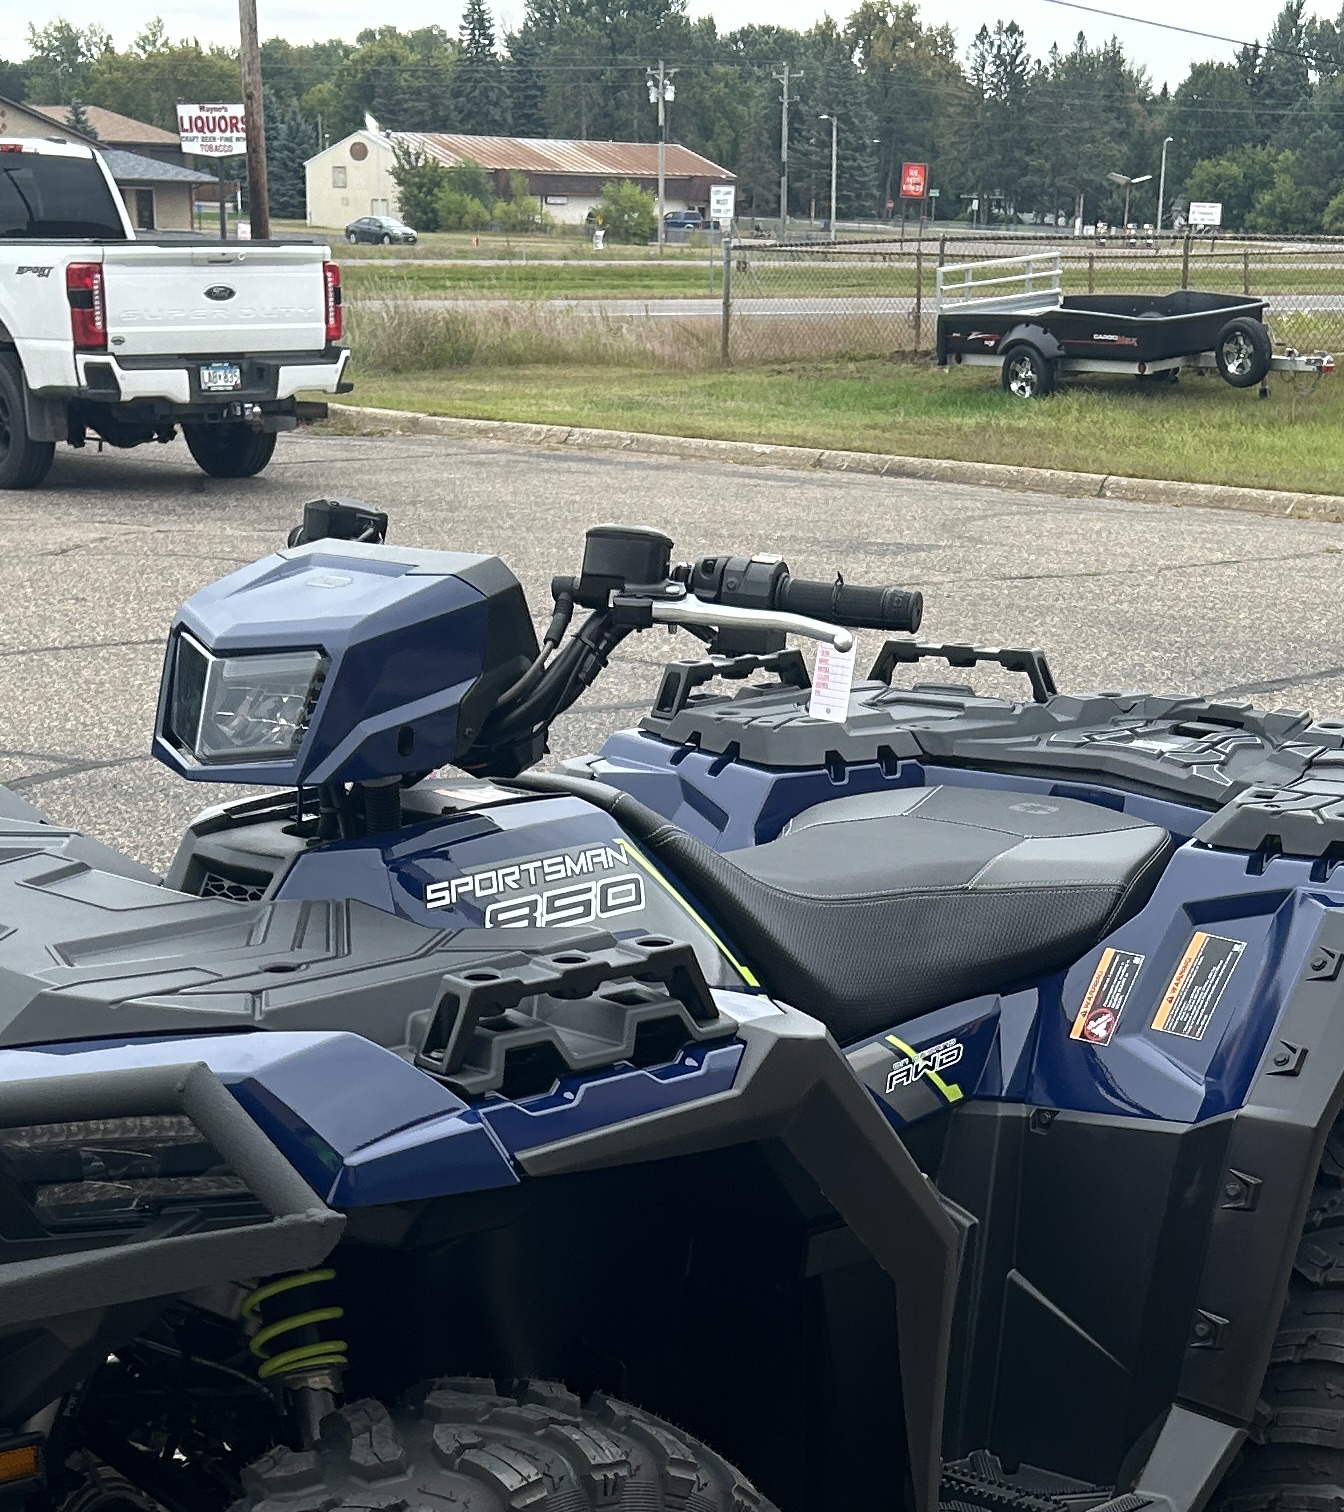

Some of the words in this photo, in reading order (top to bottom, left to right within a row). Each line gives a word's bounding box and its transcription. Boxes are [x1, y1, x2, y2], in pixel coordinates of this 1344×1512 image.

[200, 143, 234, 153] TOBACCO
[120, 307, 231, 322] SUPER
[237, 305, 315, 319] DUTY
[425, 843, 630, 909] SPORTSMAN
[484, 872, 646, 929] 850
[885, 1042, 964, 1094] AWD
